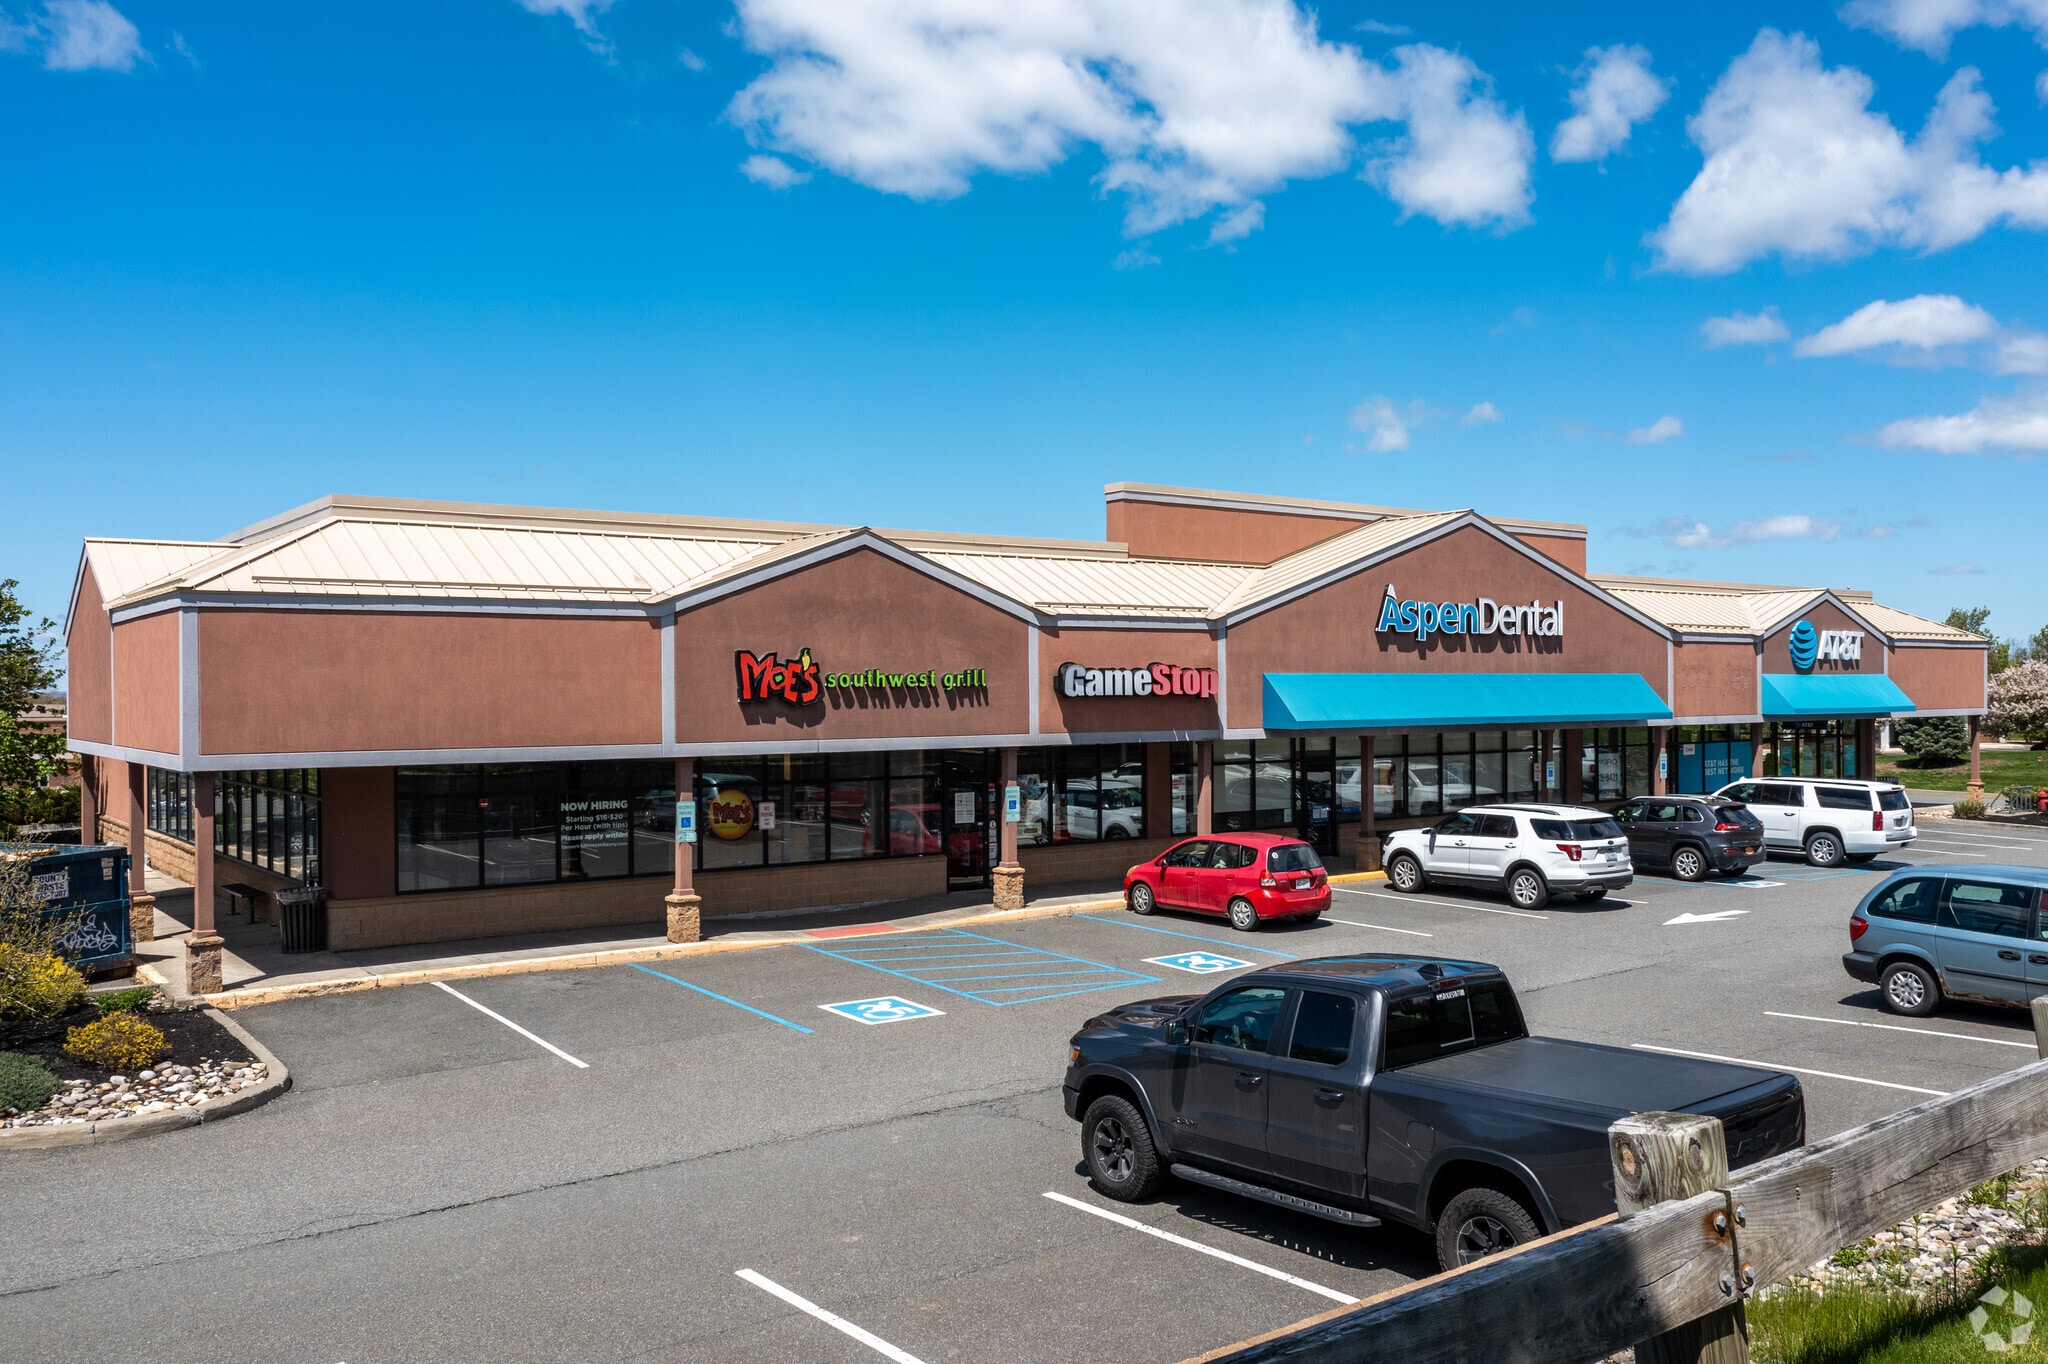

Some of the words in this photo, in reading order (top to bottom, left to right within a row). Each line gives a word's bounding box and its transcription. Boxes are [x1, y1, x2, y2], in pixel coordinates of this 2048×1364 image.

[1817, 630, 1865, 660] AT&T
[826, 669, 937, 688] southwest
[943, 668, 987, 690] grill
[1062, 662, 1219, 698] GameStop
[560, 802, 588, 811] NOW
[590, 800, 628, 810] HIRING
[565, 815, 594, 823] Starting
[585, 833, 604, 841] apply
